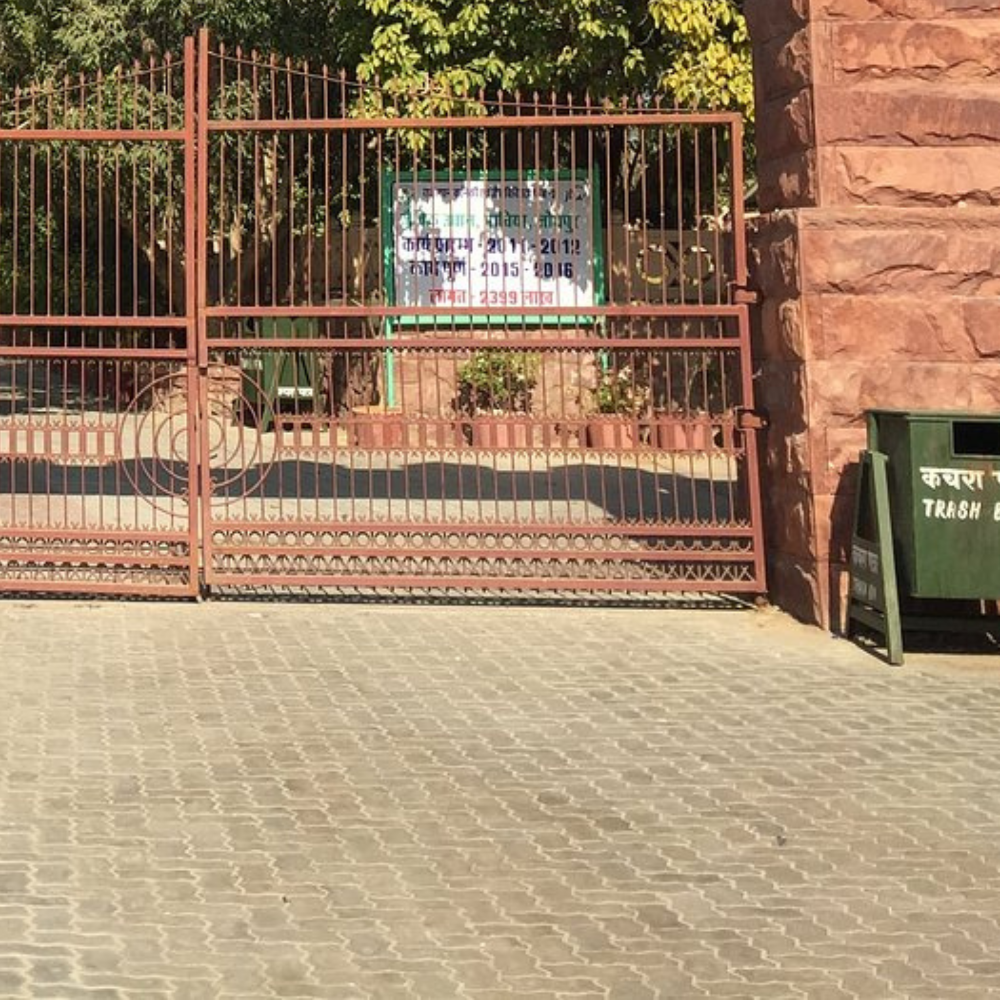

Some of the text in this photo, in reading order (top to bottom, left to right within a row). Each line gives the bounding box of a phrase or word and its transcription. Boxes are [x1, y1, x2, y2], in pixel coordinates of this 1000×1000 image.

[480, 262, 519, 278] 2015
[479, 290, 518, 305] 2399
[919, 466, 985, 491] कचरा
[922, 498, 981, 520] TRASH
